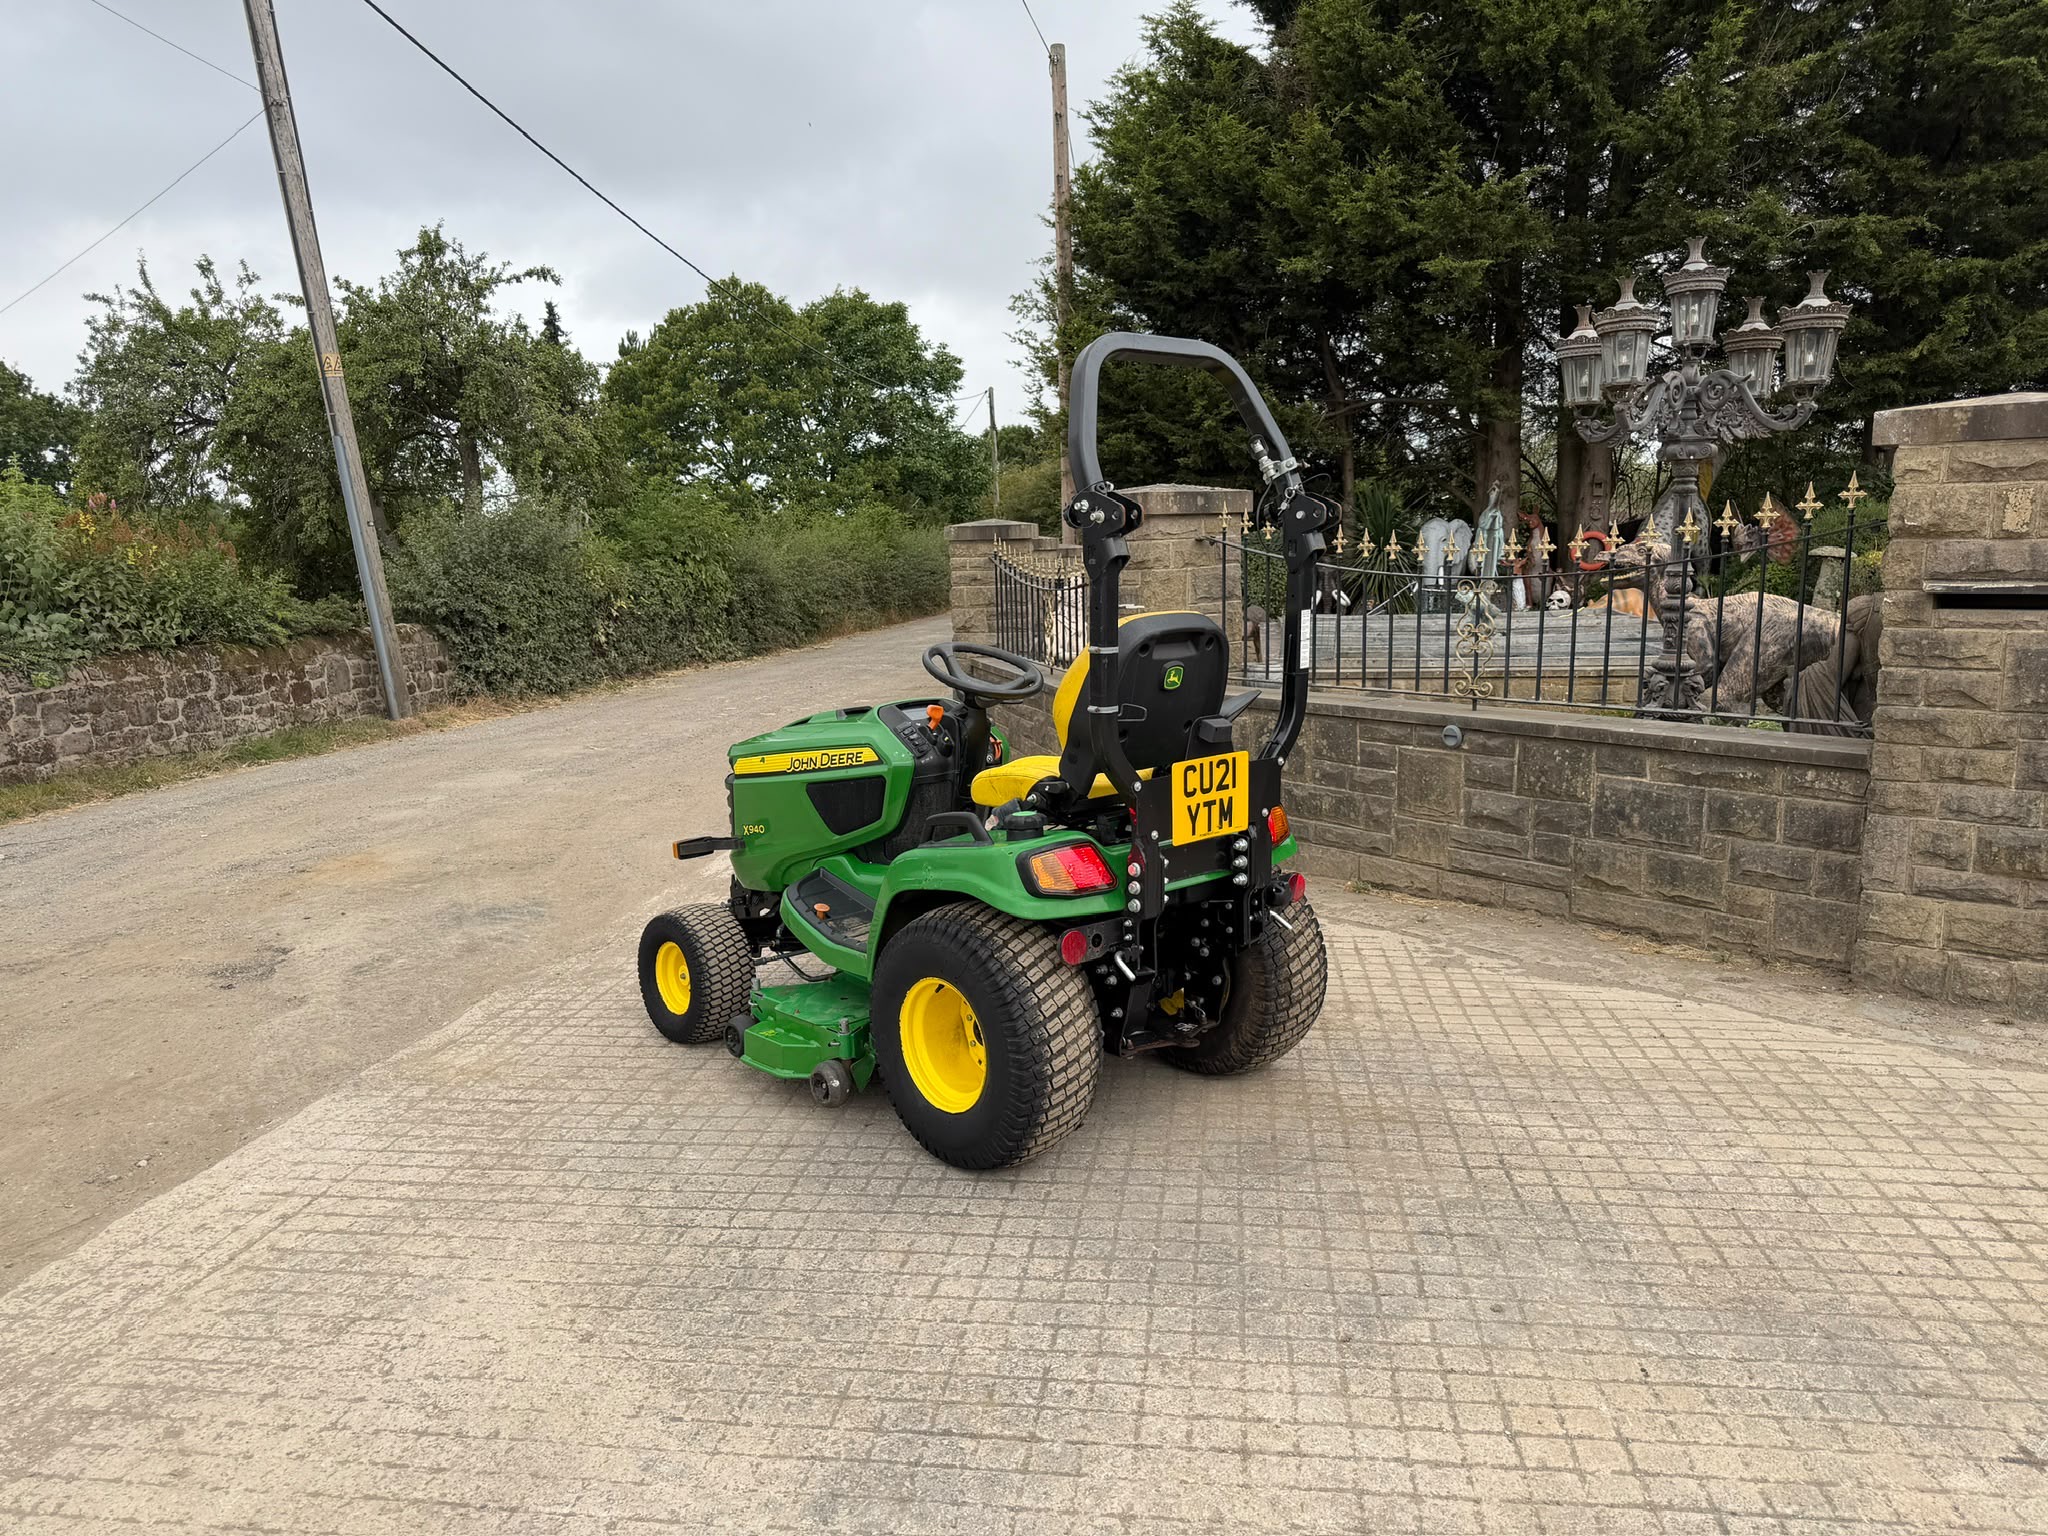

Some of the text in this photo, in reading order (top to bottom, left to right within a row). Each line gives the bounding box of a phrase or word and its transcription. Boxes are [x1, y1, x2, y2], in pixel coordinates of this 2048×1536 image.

[786, 751, 864, 771] JOHN DEERE
[1183, 756, 1237, 798] CU21
[743, 824, 765, 836] X940
[1187, 796, 1233, 836] YTM
